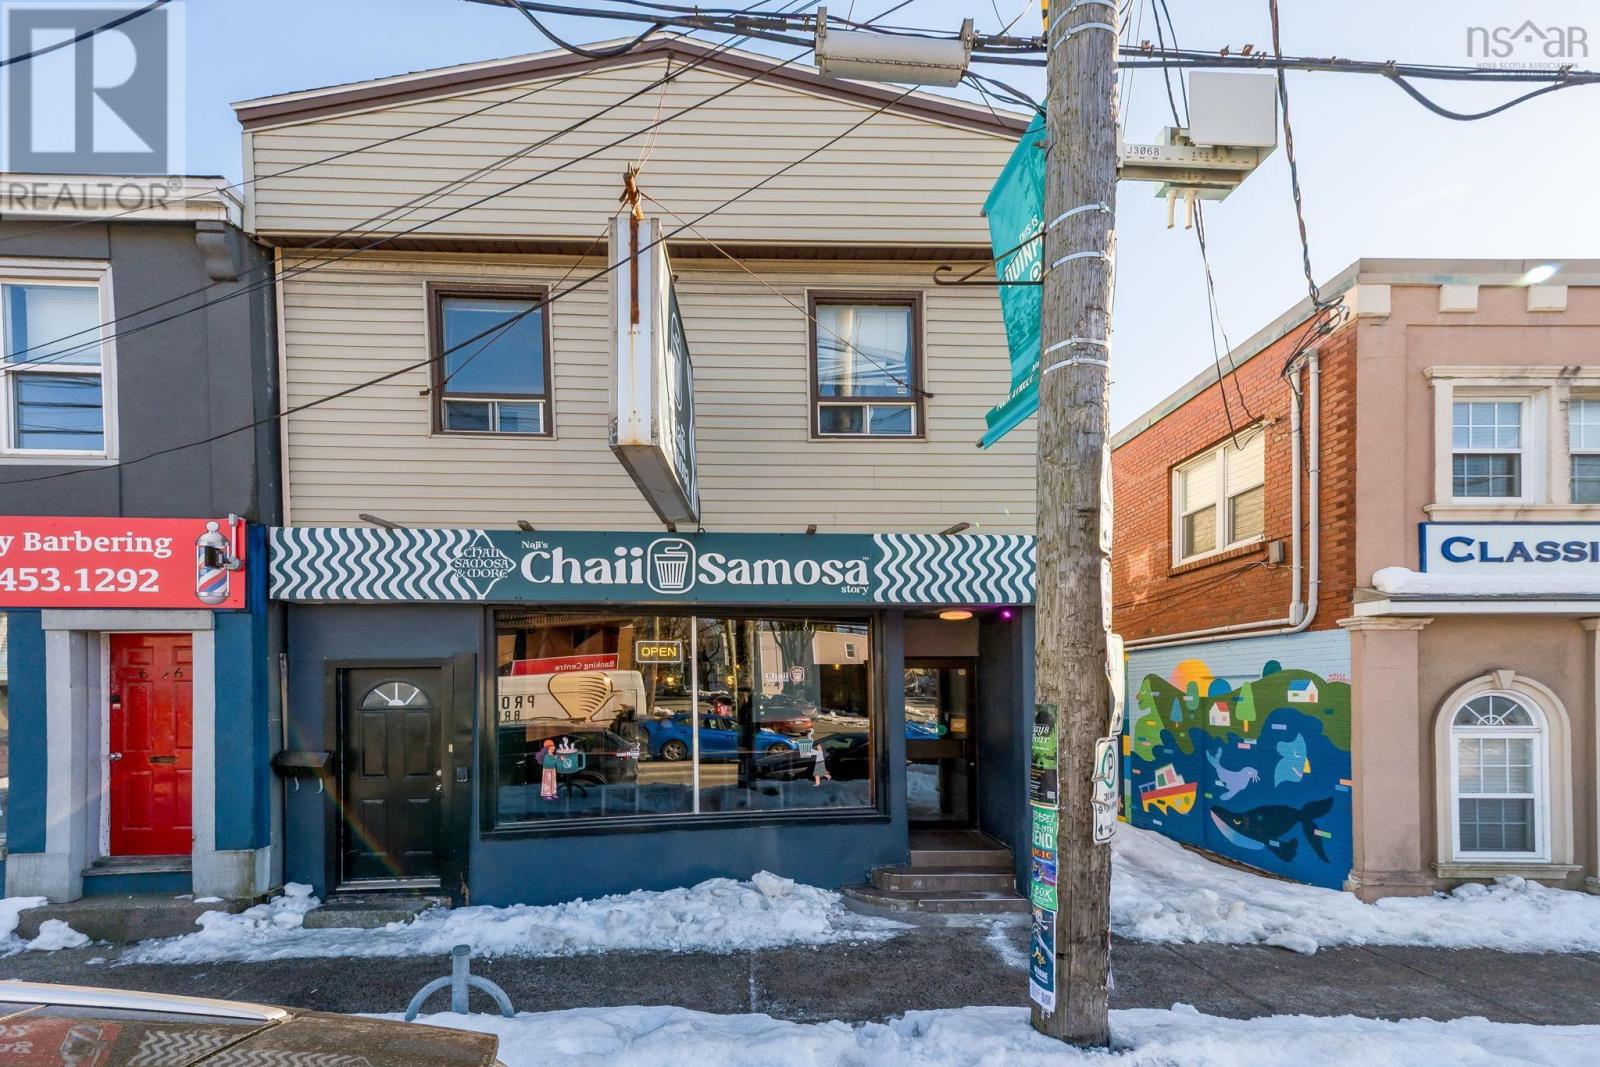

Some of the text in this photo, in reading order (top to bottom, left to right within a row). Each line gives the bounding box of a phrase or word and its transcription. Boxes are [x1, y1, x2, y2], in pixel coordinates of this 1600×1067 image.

[23, 531, 173, 558] Barbering
[521, 541, 548, 550] Naji's
[521, 547, 644, 584] Chaii
[698, 552, 870, 585] Samosa
[456, 568, 466, 578] &
[841, 585, 869, 595] story
[641, 647, 677, 657] OPEN
